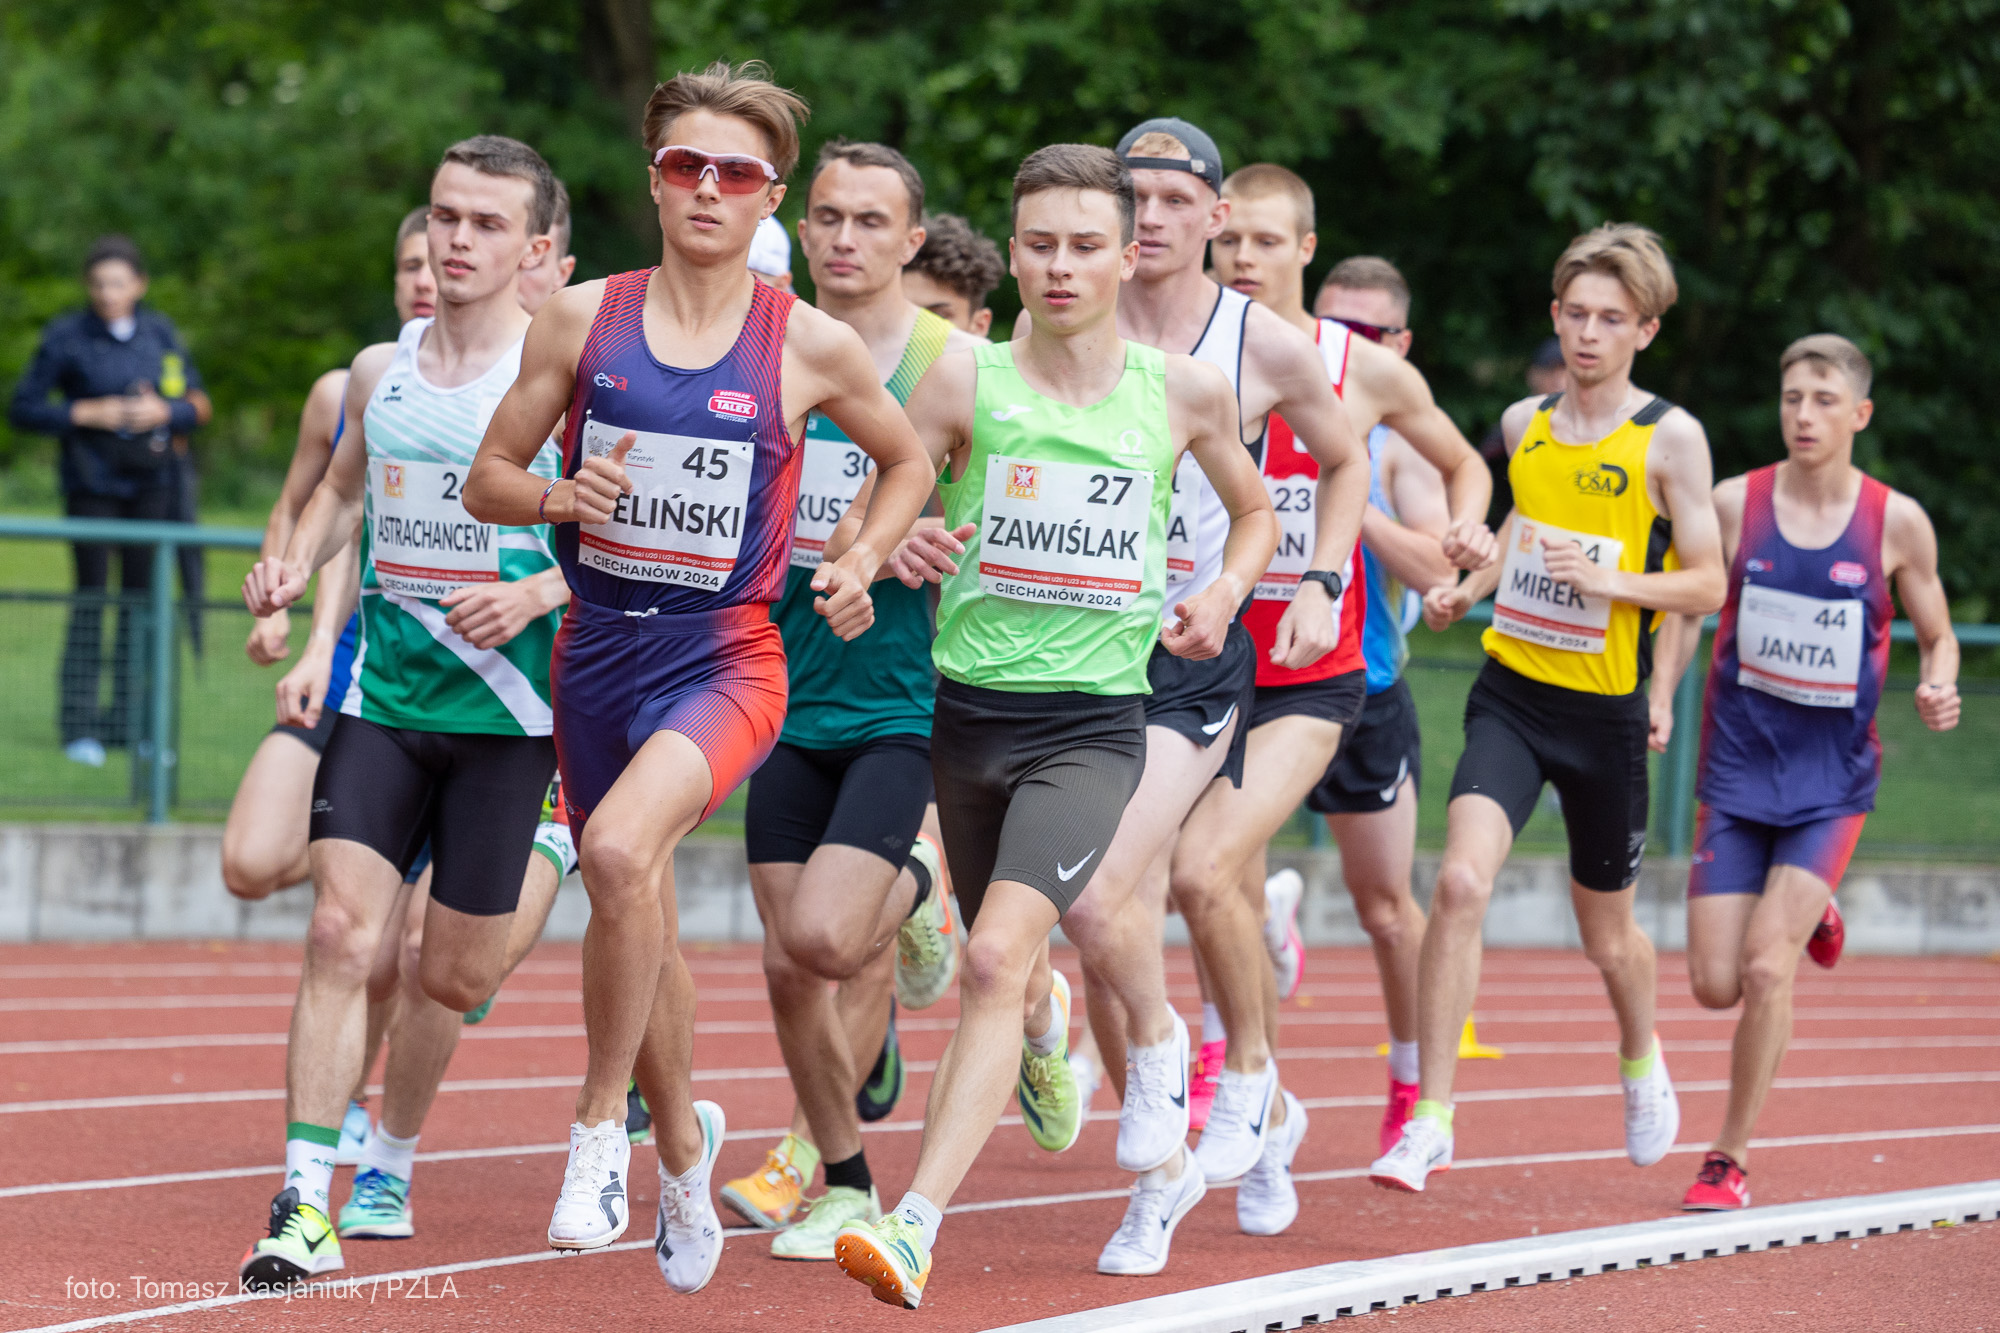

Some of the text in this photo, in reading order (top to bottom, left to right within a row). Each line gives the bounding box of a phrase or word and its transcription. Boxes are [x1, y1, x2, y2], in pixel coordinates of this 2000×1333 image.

[715, 399, 753, 414] TALEX
[682, 446, 729, 480] 45
[442, 472, 464, 500] 2
[1087, 473, 1133, 506] 27
[1274, 487, 1311, 512] 23
[613, 493, 740, 538] ELIŃSKI
[377, 514, 491, 553] ASTRACHANCEW
[987, 515, 1140, 561] ZAWIŚLAK
[662, 553, 675, 561] U23
[682, 556, 700, 565] Biegu
[1571, 539, 1600, 564] 4
[593, 554, 719, 587] CIECHANÓW 2024
[1086, 580, 1103, 588] Biegu
[385, 578, 446, 595] CIECHANÓW
[995, 582, 1122, 606] CIECHANÓW 2024
[1510, 568, 1586, 611] MIREK
[1814, 608, 1847, 630] 44
[1756, 636, 1836, 669] JANTA
